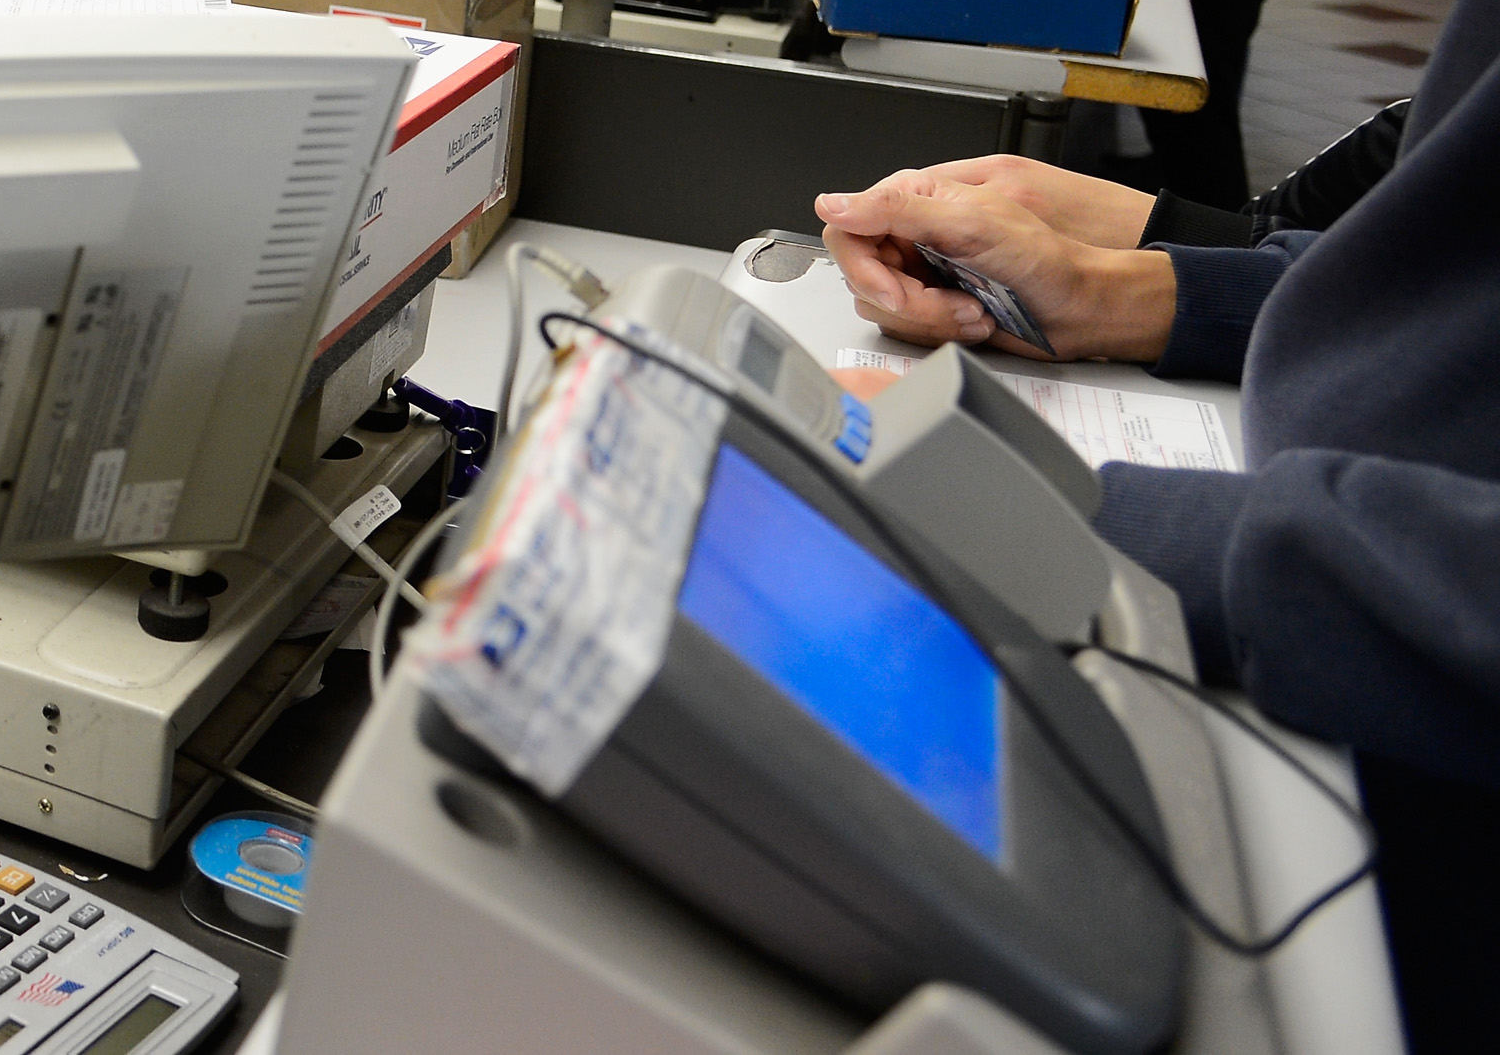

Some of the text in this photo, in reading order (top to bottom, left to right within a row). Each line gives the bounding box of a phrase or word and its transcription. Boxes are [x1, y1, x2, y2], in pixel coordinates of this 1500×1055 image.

[0, 870, 25, 886] CE
[10, 910, 29, 925] 7
[74, 905, 98, 922] OFF
[45, 927, 68, 943] MC
[18, 947, 41, 963] MR
